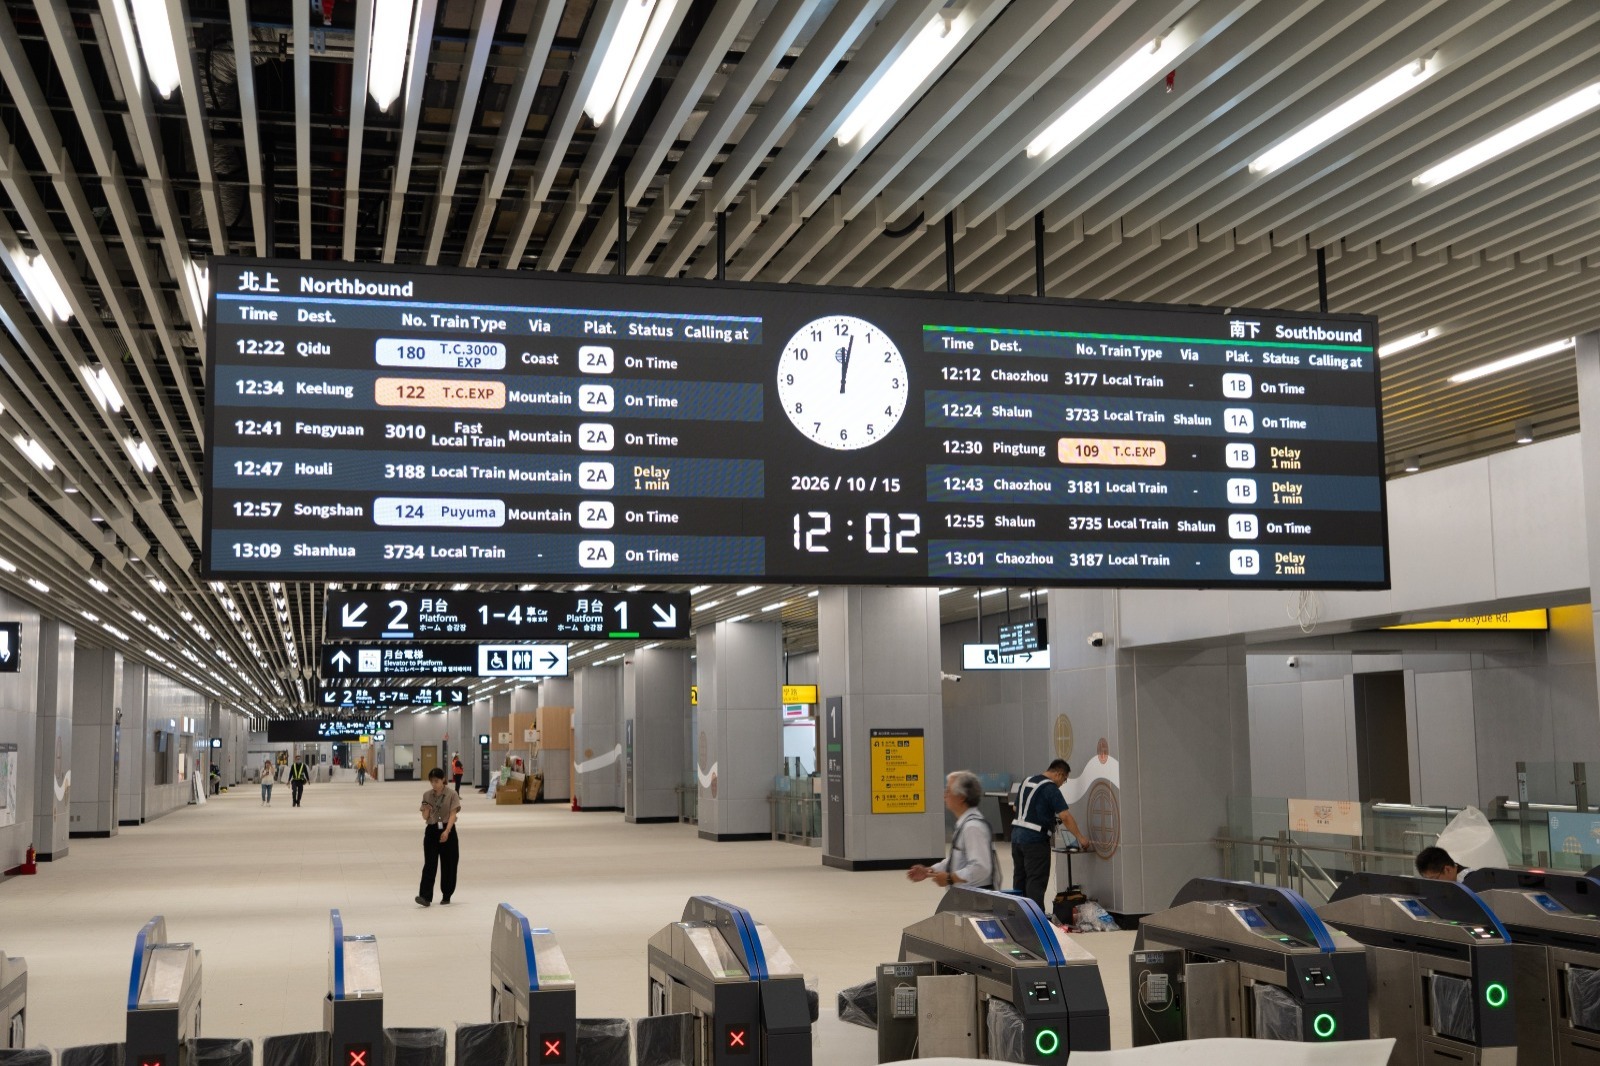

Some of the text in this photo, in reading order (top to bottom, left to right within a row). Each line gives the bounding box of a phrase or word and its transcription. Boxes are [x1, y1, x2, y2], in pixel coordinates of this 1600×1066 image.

[239, 272, 280, 292] 北上
[300, 276, 413, 296] Northbound
[239, 307, 748, 342] Time Dest. No. Train Type Via Plat. Status Calling at
[1230, 321, 1261, 339] 南下
[1276, 326, 1362, 342] Southbound
[237, 340, 678, 369] 12:22 Qidu 180 T.C.3000 Coast 2A On Time
[458, 357, 481, 368] EXP
[942, 337, 1362, 369] Time Dest. No. Train Type Via Plat. Status Calling at
[941, 368, 1305, 394] 12:12 Chaozhou 3177 Local Train 1B On Time
[236, 380, 678, 407] 12:34 Keelung 122 T.C.EXP Mountain 2A On Time
[942, 404, 1306, 429] 12:24 Shalun 3733 Local Train Shalun 1A On Time
[235, 421, 678, 446] 12:41 Fengyuan 3010 Fast Mountain 2A On Time
[432, 435, 505, 447] Local Train
[943, 441, 1301, 462] 12:30 Pingtung 109 T.C.EXP 1B Delay
[234, 461, 670, 482] 12:47 Houli 3188 Local Train Mountain 2A Delay
[634, 479, 670, 490] 1 min
[792, 476, 900, 492] 2026 10 15
[943, 478, 1302, 497] 12:43 Chaozhou 3181 Local Train 1B Delay
[233, 502, 679, 523] 12:57 Songshan 124 Puyuma Mountain 2A On Time
[945, 515, 1311, 534] 12:55 Shalun 3735 Local Train Shalun 1B On Time
[233, 543, 679, 562] 13:09 Shanhua 3734 Local Train 2A On Time
[945, 552, 1305, 568] 13:01 Chaozhou 3187 Local Train 1B Delay
[1275, 565, 1305, 574] 2 min
[388, 600, 409, 629] 2
[420, 599, 448, 613] 月台
[576, 599, 603, 613] 月台
[614, 602, 627, 629] 1
[420, 614, 457, 622] Platform
[567, 614, 603, 622] Platform
[1496, 612, 1510, 622] Rd.
[344, 691, 352, 703] 2
[436, 690, 442, 702] 1
[831, 706, 835, 738] 1
